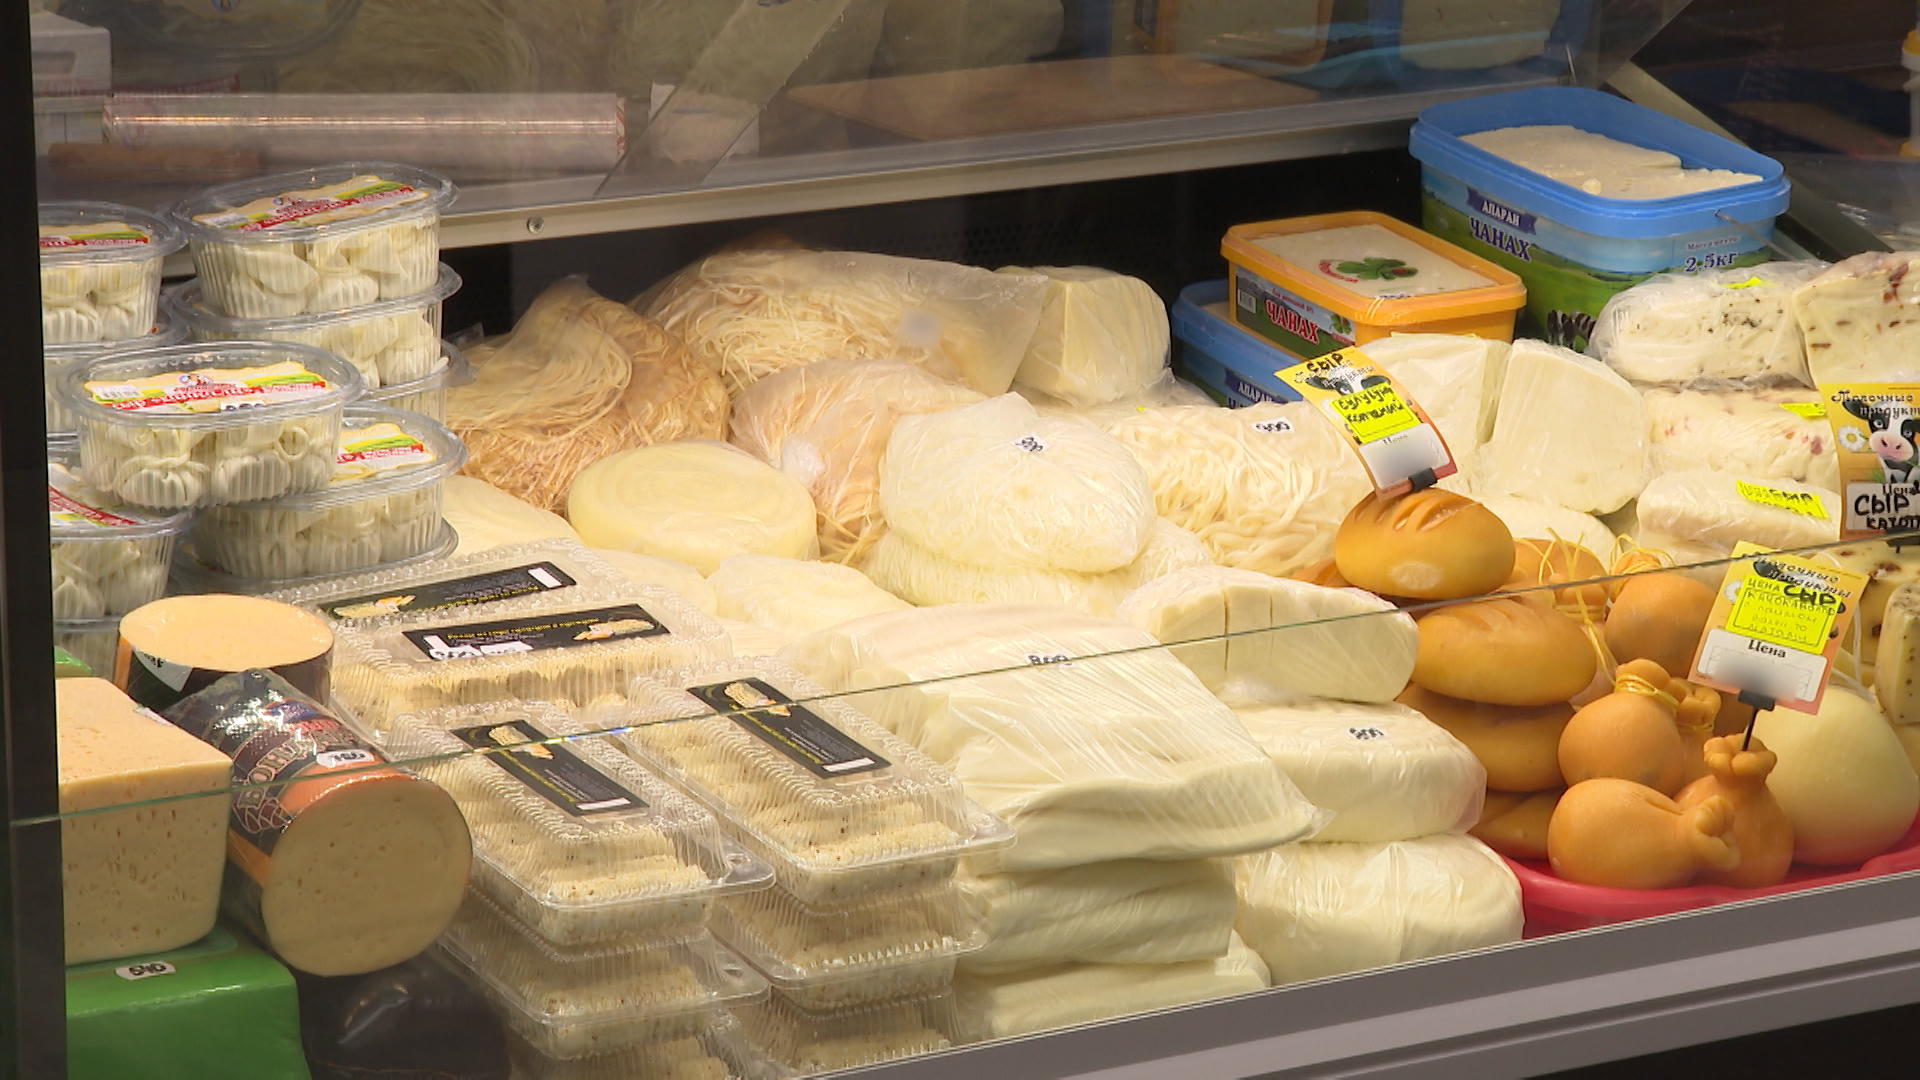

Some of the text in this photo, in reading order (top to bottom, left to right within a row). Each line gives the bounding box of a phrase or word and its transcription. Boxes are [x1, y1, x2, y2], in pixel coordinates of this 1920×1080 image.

[1481, 200, 1520, 227] АПАРАН
[1469, 217, 1531, 262] ЧАНАХ
[1265, 300, 1320, 345] ЧАНАХ
[1307, 353, 1343, 373] СЫР
[1854, 493, 1910, 516] СЫР
[1784, 584, 1837, 607] СЫР
[1748, 639, 1787, 659] Цена
